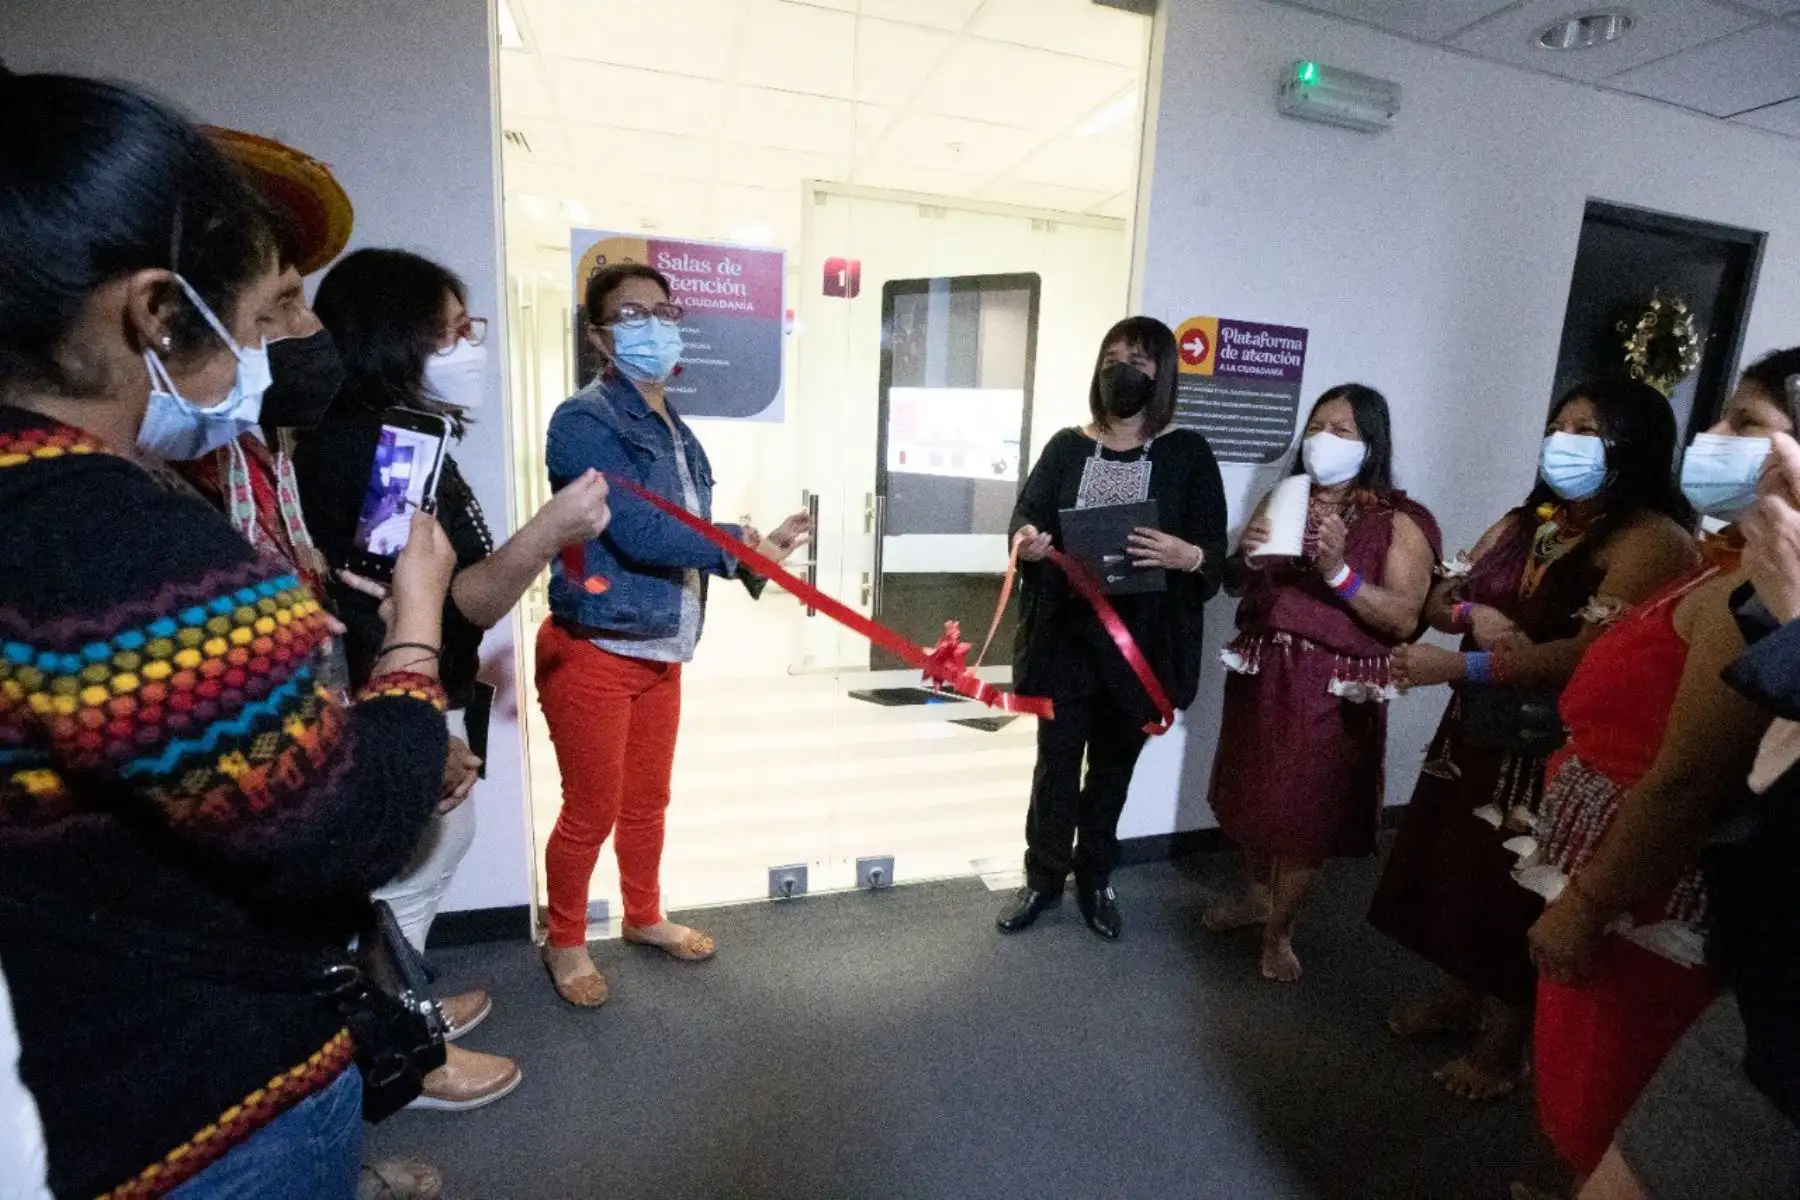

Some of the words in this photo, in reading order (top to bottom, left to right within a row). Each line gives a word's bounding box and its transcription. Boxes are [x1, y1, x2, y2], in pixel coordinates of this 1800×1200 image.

[657, 251, 712, 273] Salas
[717, 256, 742, 276] de
[837, 269, 846, 287] 1
[685, 297, 754, 311] CIUDADANÍA
[1221, 327, 1303, 351] Plataforma
[1220, 344, 1239, 360] de
[1241, 348, 1301, 366] atención
[1218, 363, 1226, 371] A
[1226, 363, 1237, 372] LA
[1237, 365, 1284, 377] CIUDADANÍA
